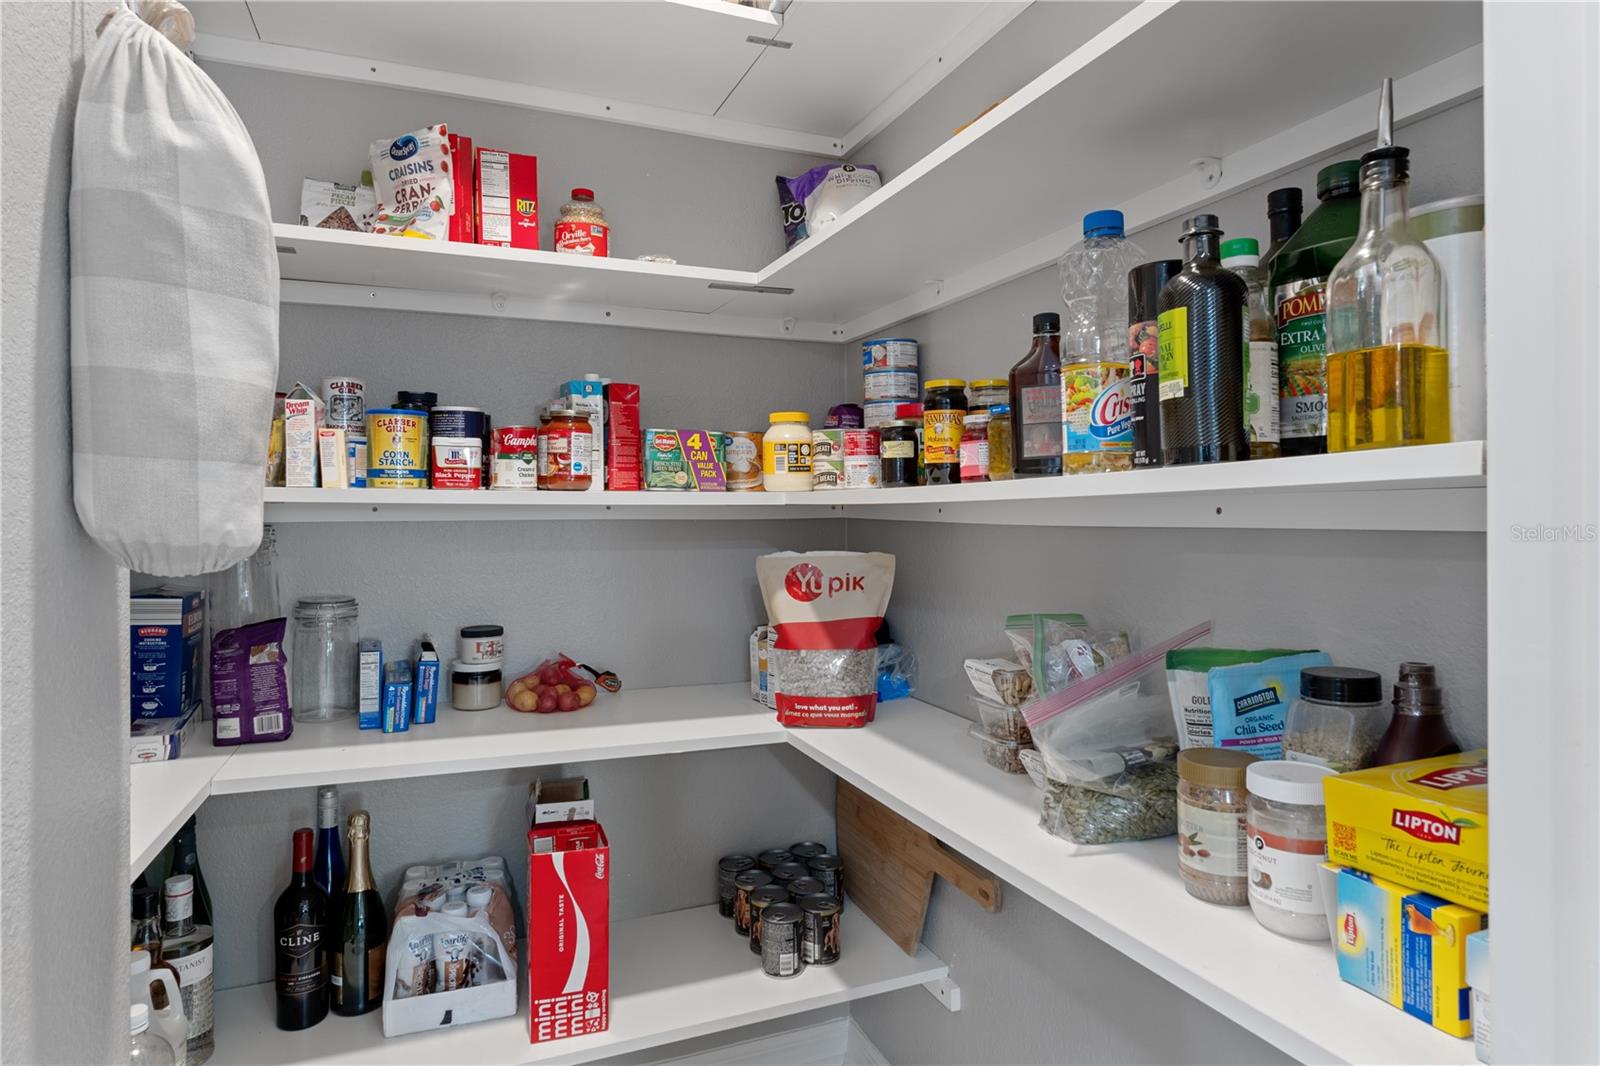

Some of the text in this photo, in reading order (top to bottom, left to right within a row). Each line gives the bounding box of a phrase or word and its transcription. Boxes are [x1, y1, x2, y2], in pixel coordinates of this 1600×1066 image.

[388, 160, 434, 181] CRAISINS
[395, 183, 436, 204] CRAN-
[392, 200, 423, 214] BERR
[516, 198, 536, 213] RITZ
[562, 230, 586, 240] Orville
[1280, 331, 1320, 346] EXTRA
[1100, 392, 1132, 424] Cris
[376, 418, 416, 428] CLABBER
[1107, 424, 1120, 436] Pure
[687, 433, 702, 449] 4
[379, 458, 414, 466] STARCH
[691, 451, 707, 460] CAN
[701, 470, 717, 478] PACK
[1245, 714, 1274, 723] ORGANIC
[1234, 720, 1284, 736] Chia Seed
[1395, 812, 1457, 841] LIPTON
[1381, 837, 1488, 879] The Lipton Journ
[1346, 915, 1356, 946] Lipton
[280, 931, 320, 946] CLINE
[534, 998, 551, 1040] mini
[552, 996, 567, 1038] mini
[568, 994, 583, 1034] mini
